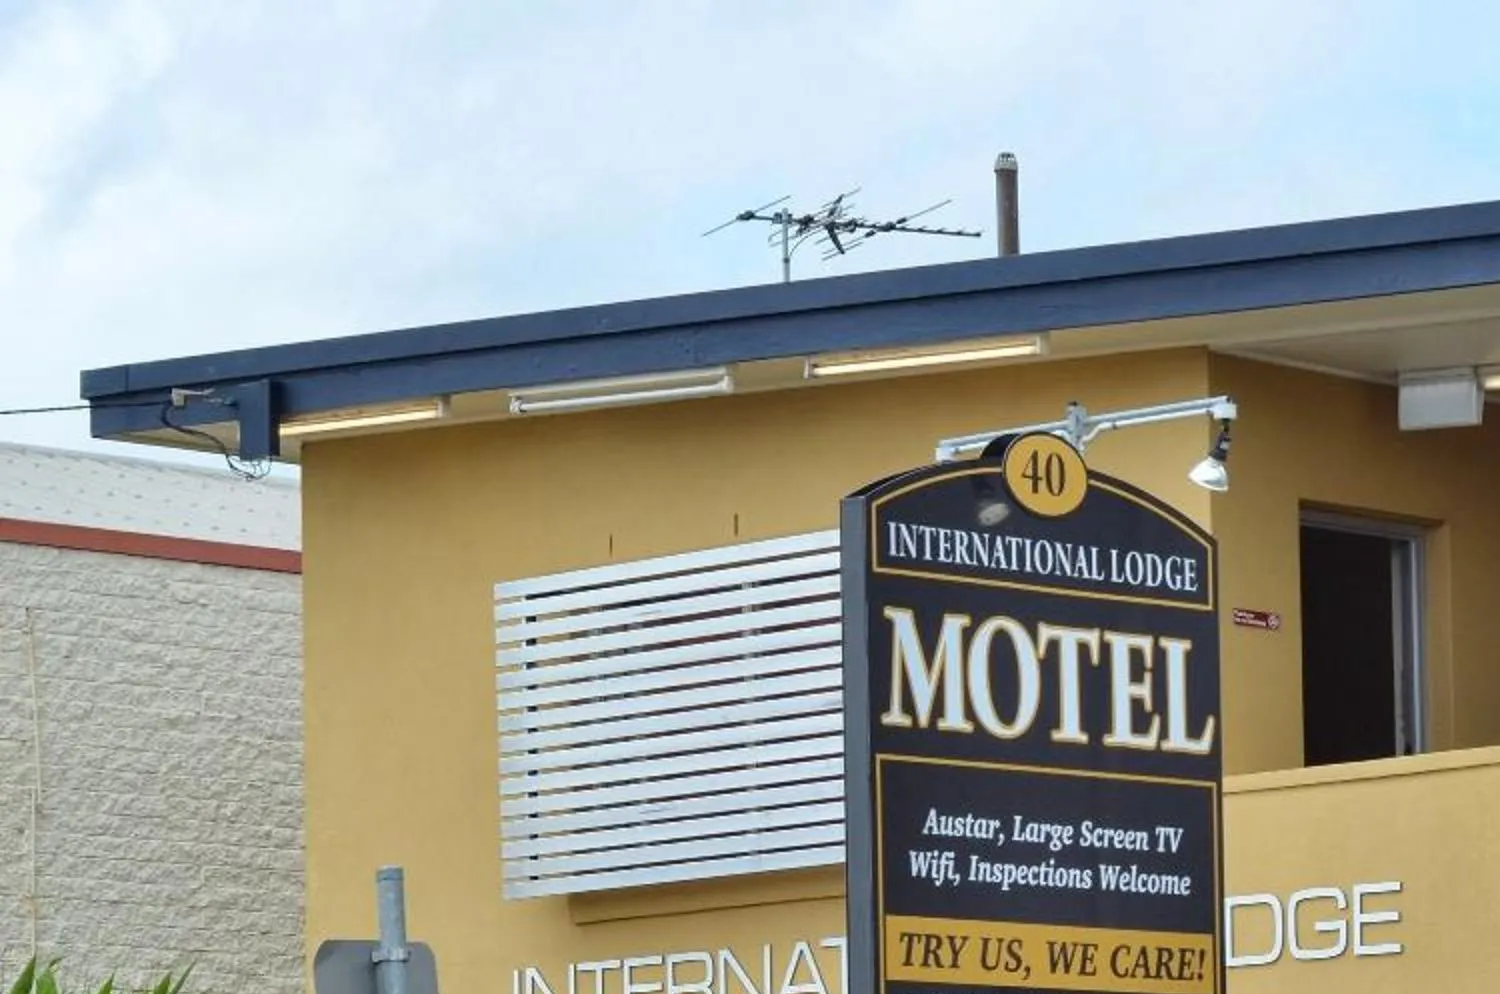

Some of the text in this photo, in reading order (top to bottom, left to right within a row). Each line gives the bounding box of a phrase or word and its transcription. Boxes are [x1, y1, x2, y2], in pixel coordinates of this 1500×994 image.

[1022, 449, 1066, 496] 40
[887, 521, 1199, 592] INTERNATIONAL LODGE
[881, 606, 1215, 754] MOTEL
[922, 808, 1183, 853] Austar, Large Screen TV
[909, 850, 1191, 896] Wifi, Inspections Welcome
[900, 931, 1206, 982] TRY US, WE CARE!
